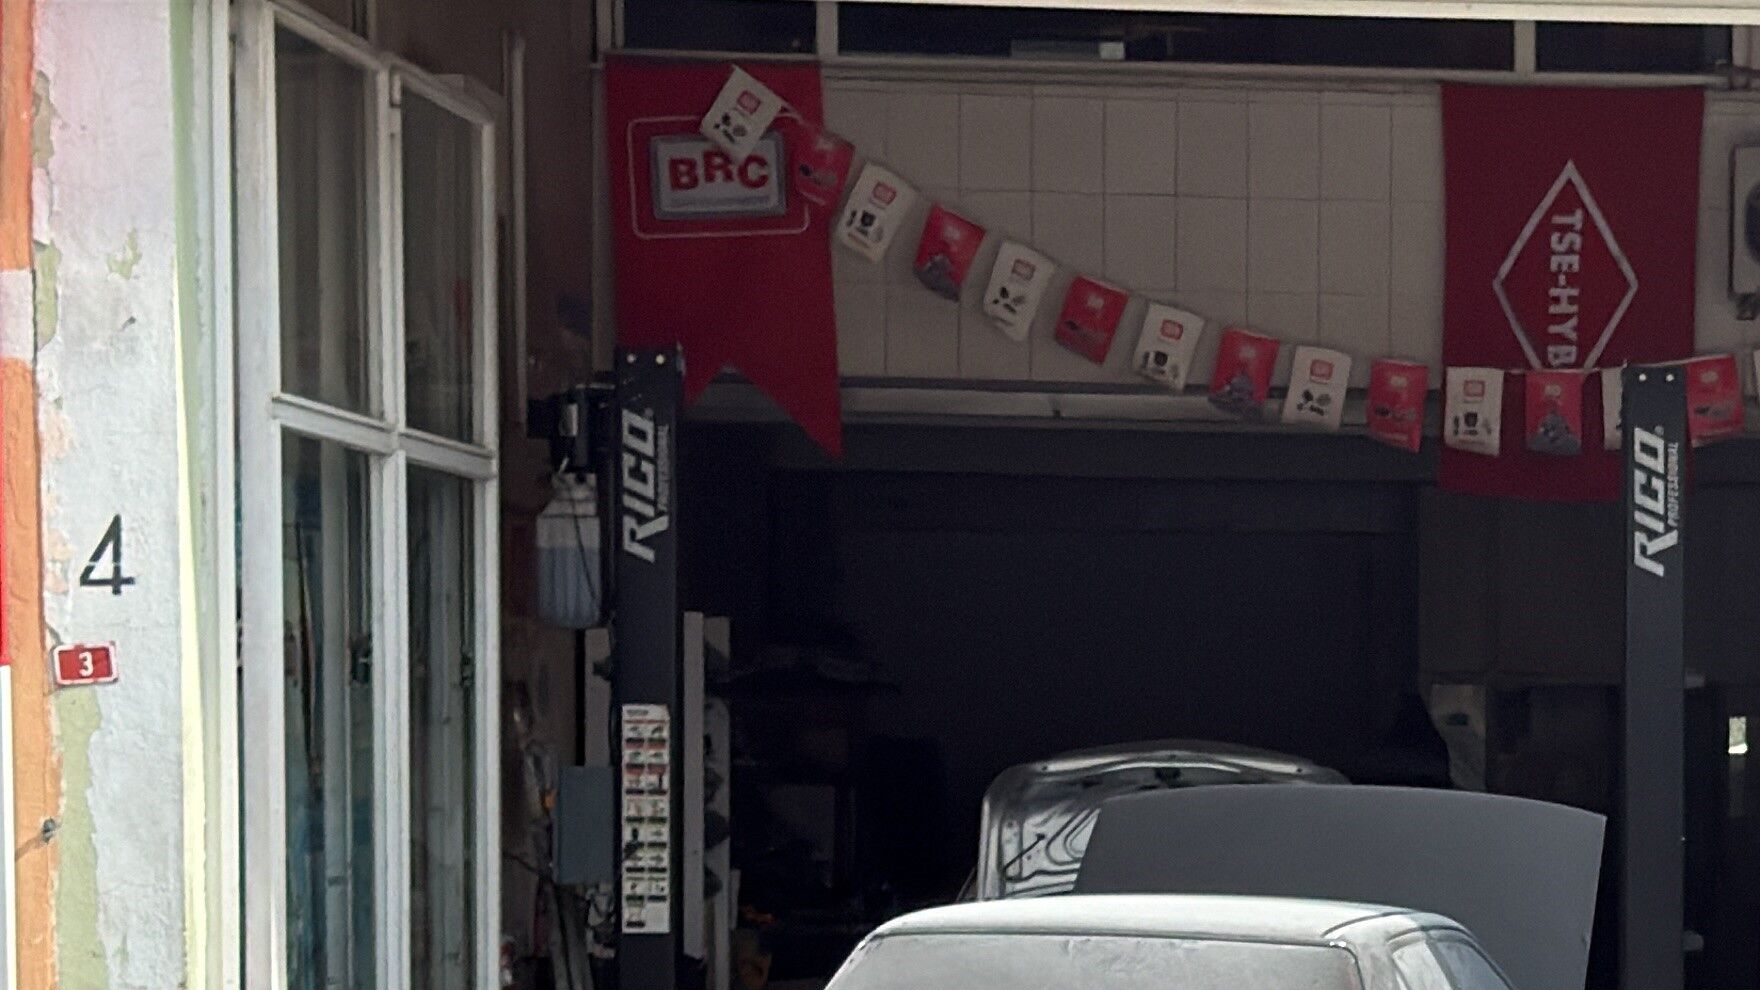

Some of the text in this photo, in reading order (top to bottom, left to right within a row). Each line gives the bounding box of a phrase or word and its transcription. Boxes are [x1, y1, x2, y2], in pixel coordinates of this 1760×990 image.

[668, 149, 769, 190] BRC
[1547, 208, 1583, 367] TSE-HYB
[622, 408, 669, 564] RICO
[1634, 427, 1679, 577] RICO
[79, 513, 136, 596] 4
[78, 652, 94, 677] 3
